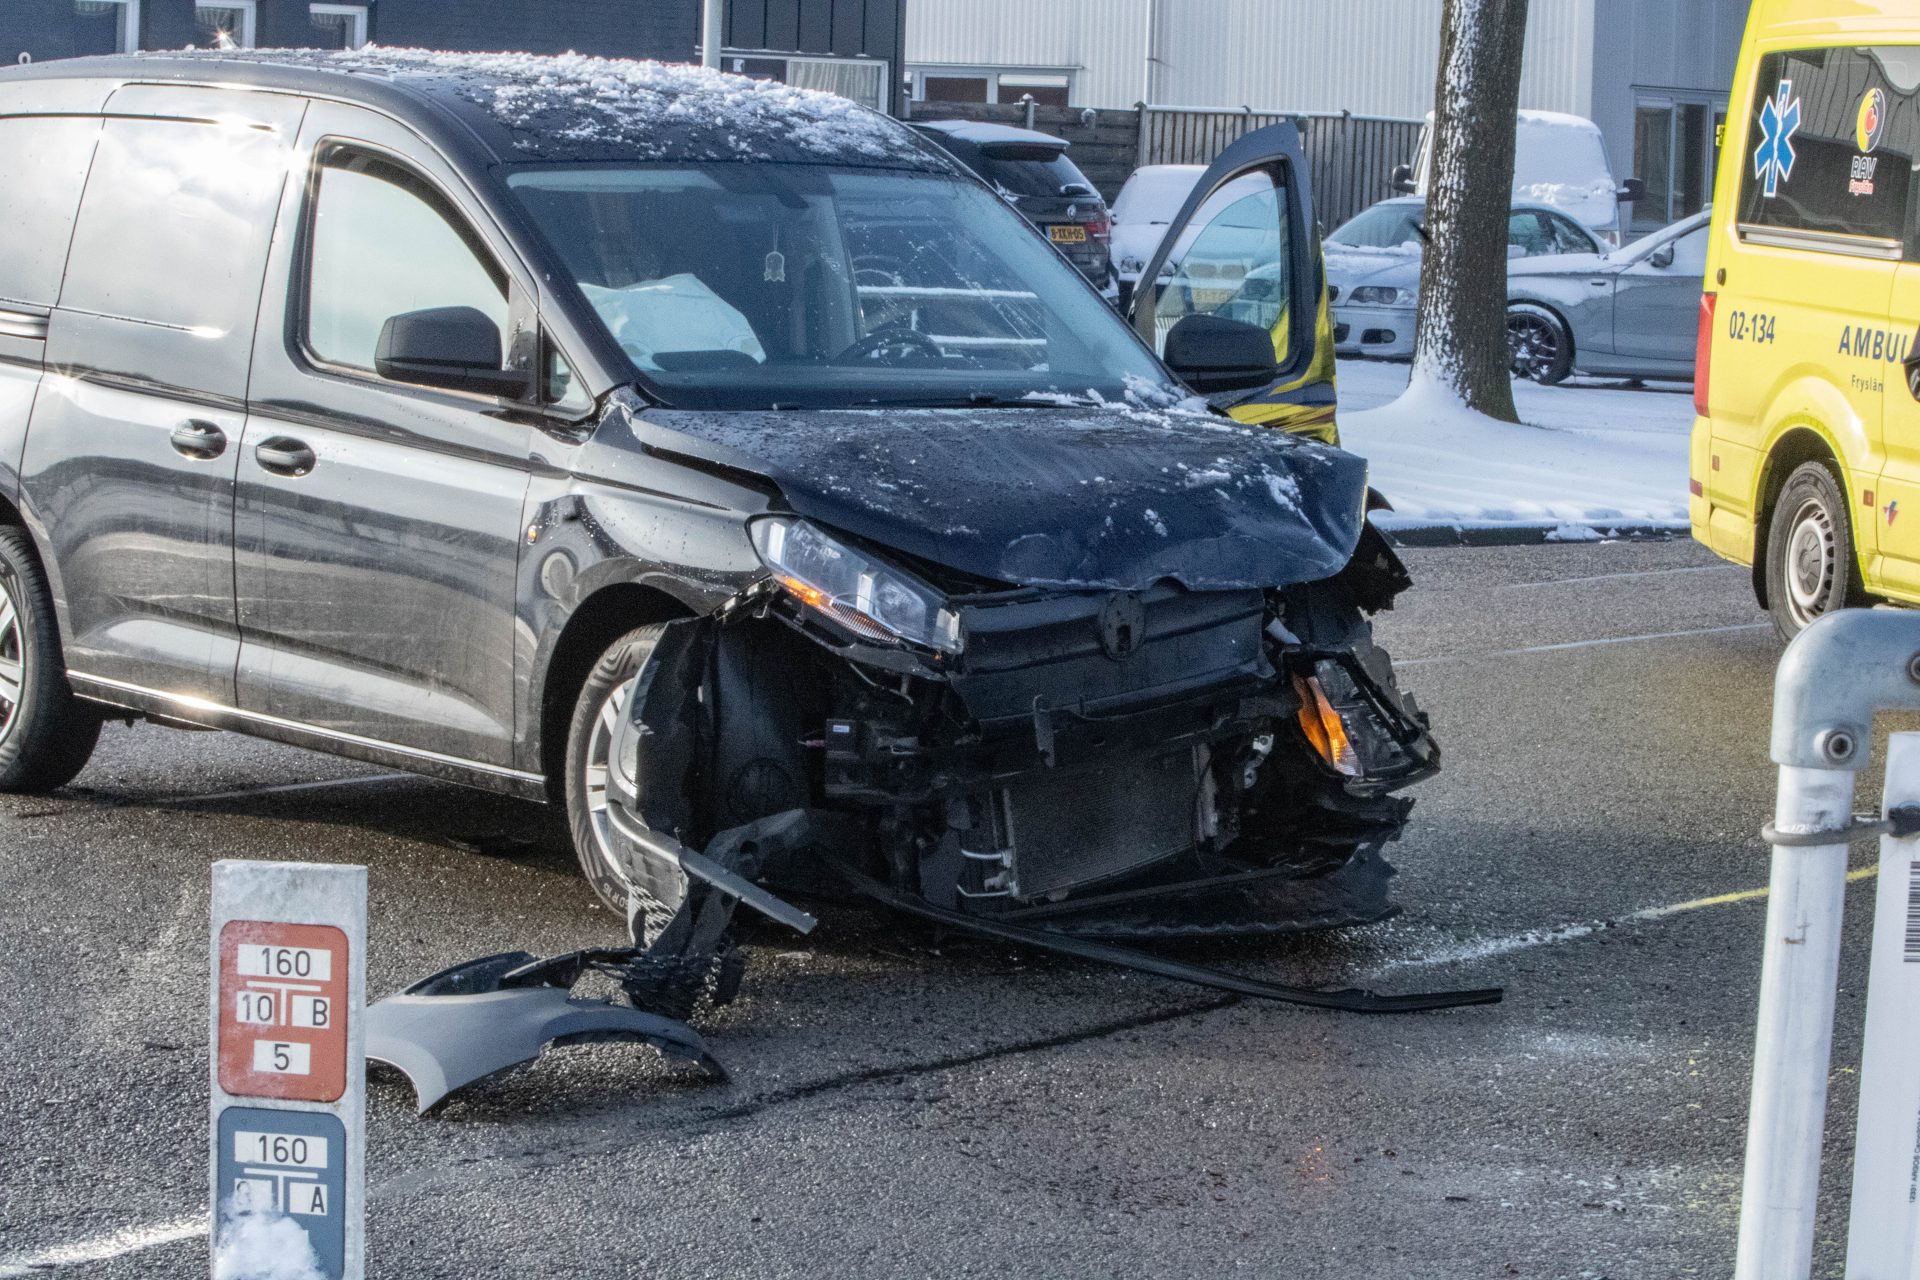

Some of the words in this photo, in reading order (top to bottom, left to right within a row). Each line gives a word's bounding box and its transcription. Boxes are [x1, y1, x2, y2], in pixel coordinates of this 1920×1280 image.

[1851, 155, 1878, 180] RAV
[1729, 310, 1776, 344] 02-134
[261, 947, 311, 977] 160
[242, 994, 273, 1022] 10
[312, 998, 328, 1027] B
[274, 1043, 290, 1071] 5
[258, 1135, 307, 1164] 160
[310, 1185, 325, 1213] A
